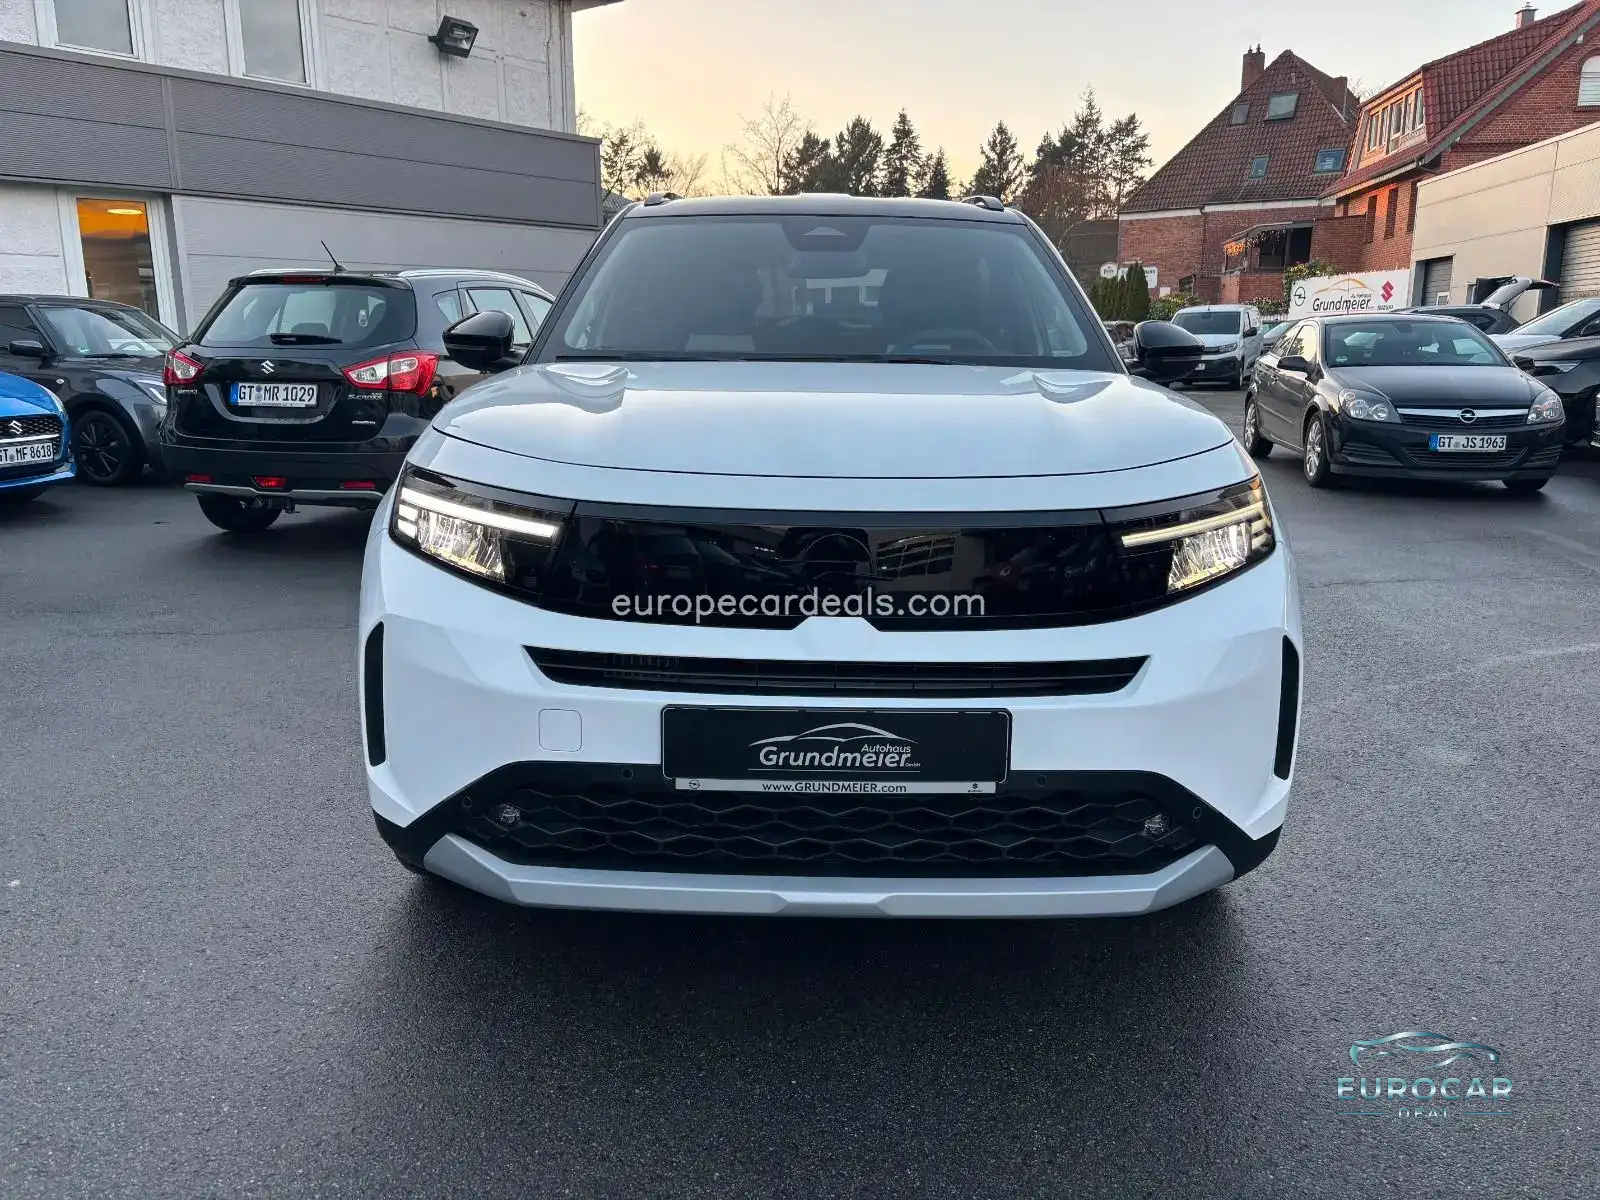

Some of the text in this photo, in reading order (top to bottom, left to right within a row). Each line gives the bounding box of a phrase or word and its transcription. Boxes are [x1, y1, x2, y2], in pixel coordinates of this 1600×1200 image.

[1312, 296, 1371, 312] Grundmeier
[239, 385, 315, 402] GT MR 1029
[1438, 436, 1505, 449] GT JS 1963
[15, 446, 28, 461] MF
[29, 444, 52, 459] 8618
[861, 743, 912, 753] Autohaus
[759, 745, 911, 768] Grundmeier
[762, 782, 907, 793] www.GRUNDMEIER.com
